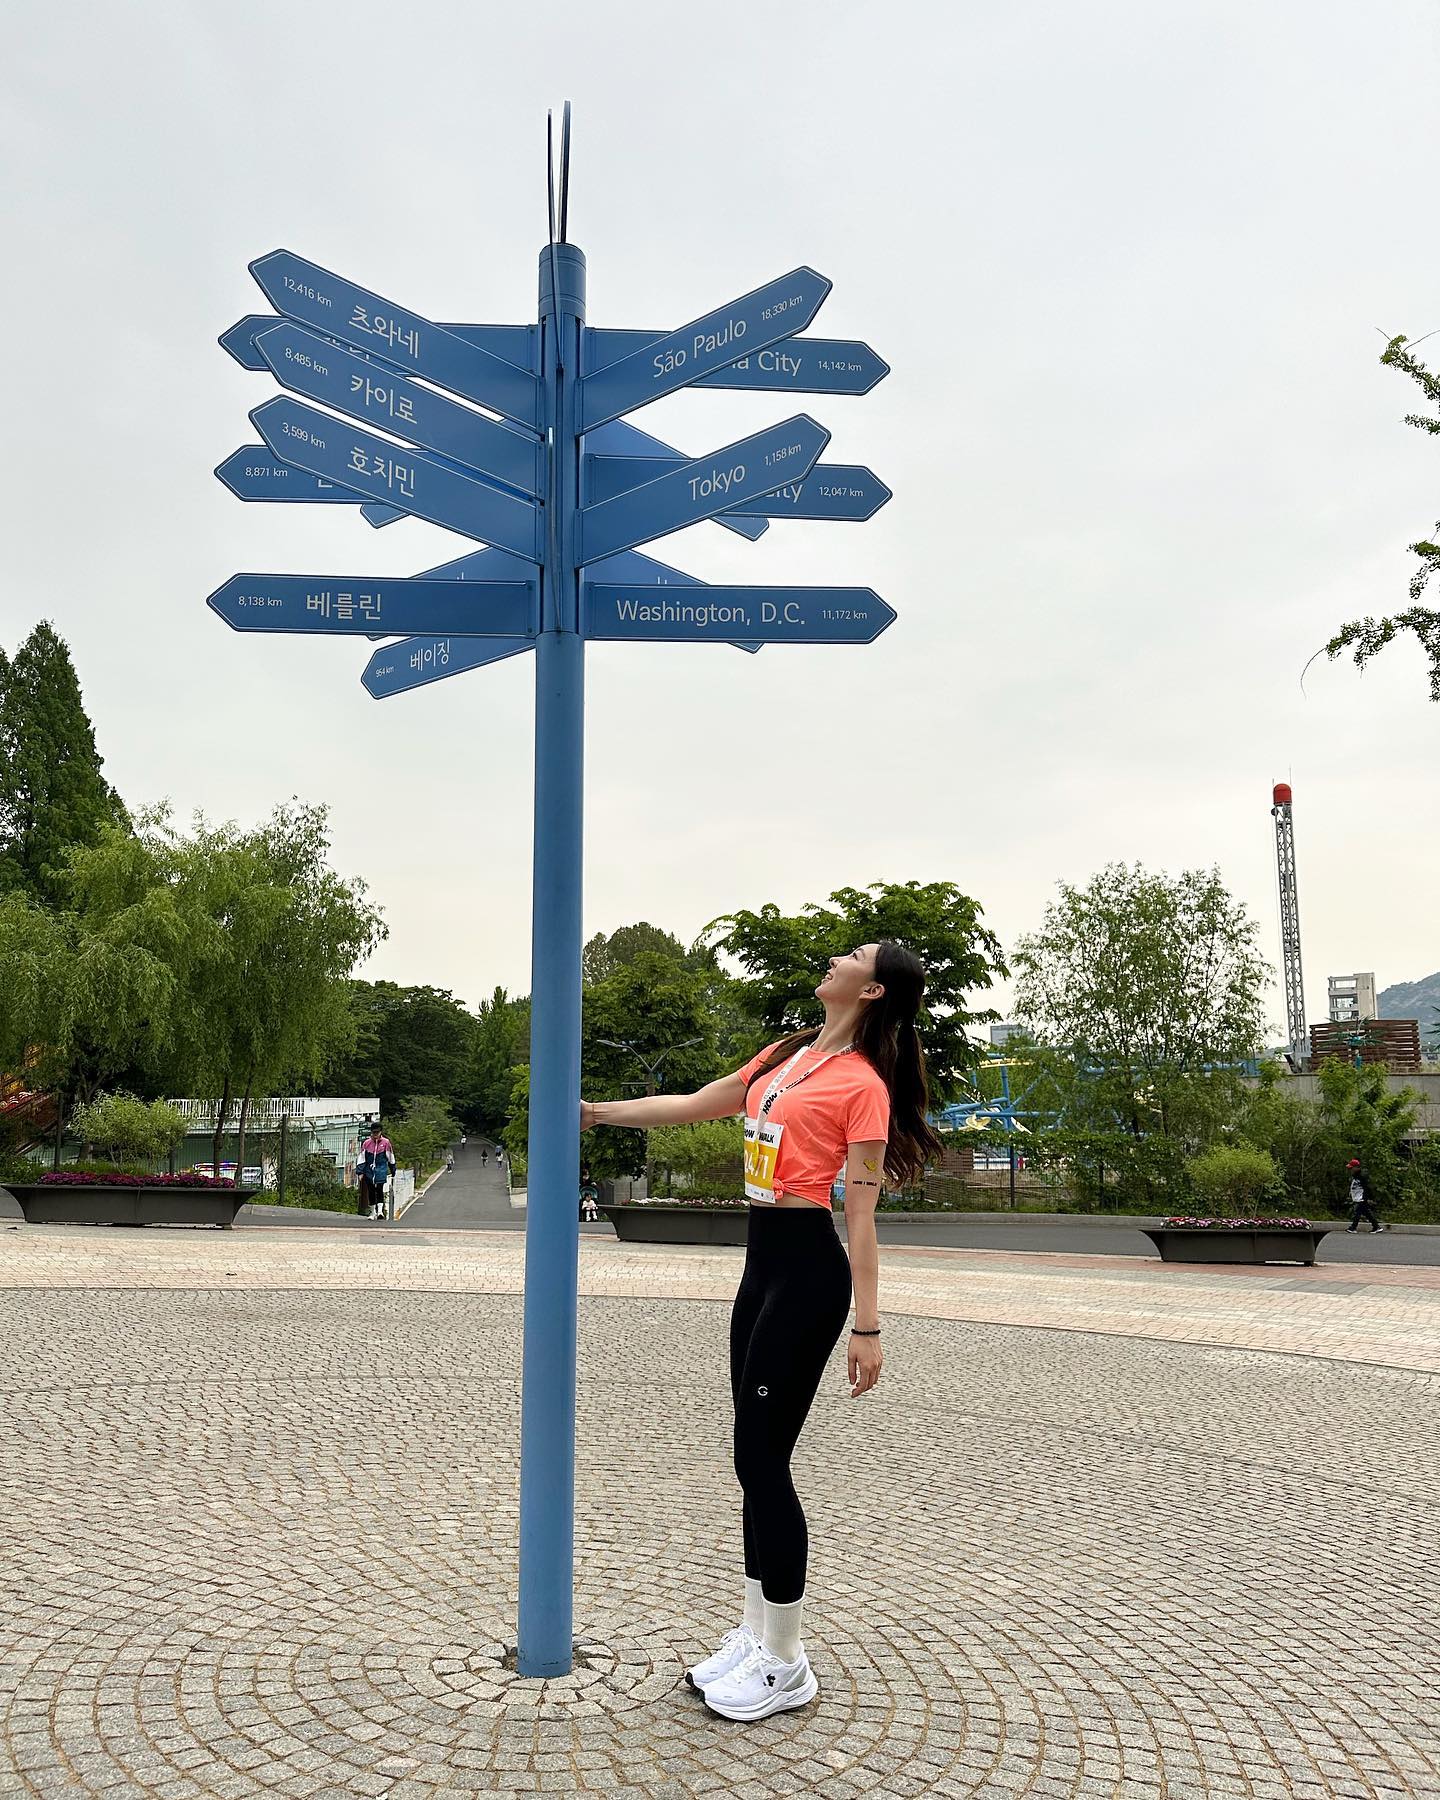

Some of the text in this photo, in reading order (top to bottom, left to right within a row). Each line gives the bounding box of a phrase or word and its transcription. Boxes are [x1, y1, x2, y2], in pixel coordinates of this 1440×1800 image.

[283, 276, 332, 308] 12,416 km
[760, 294, 803, 322] 18,330 km
[348, 304, 419, 358] 츠와네
[285, 347, 312, 368] 8,485
[312, 358, 328, 376] km
[652, 319, 747, 378] São Paulo
[758, 351, 802, 376] City
[817, 360, 862, 372] 14,142 km
[350, 374, 418, 424] 카이로
[282, 422, 326, 449] 3,599 km
[764, 442, 802, 467] 1,158 km
[244, 466, 288, 478] 8,871 km
[347, 446, 416, 498] 호치민
[688, 464, 746, 502] Tokyo
[818, 486, 864, 498] 12,047 km
[238, 596, 282, 608] 8,138 km
[306, 592, 382, 620] 베를린
[616, 599, 806, 626] Washington, D.C.
[821, 609, 868, 620] 11,172 km
[410, 638, 450, 671] 베이징
[762, 1092, 778, 1115] HOW
[758, 1132, 775, 1143] WALK
